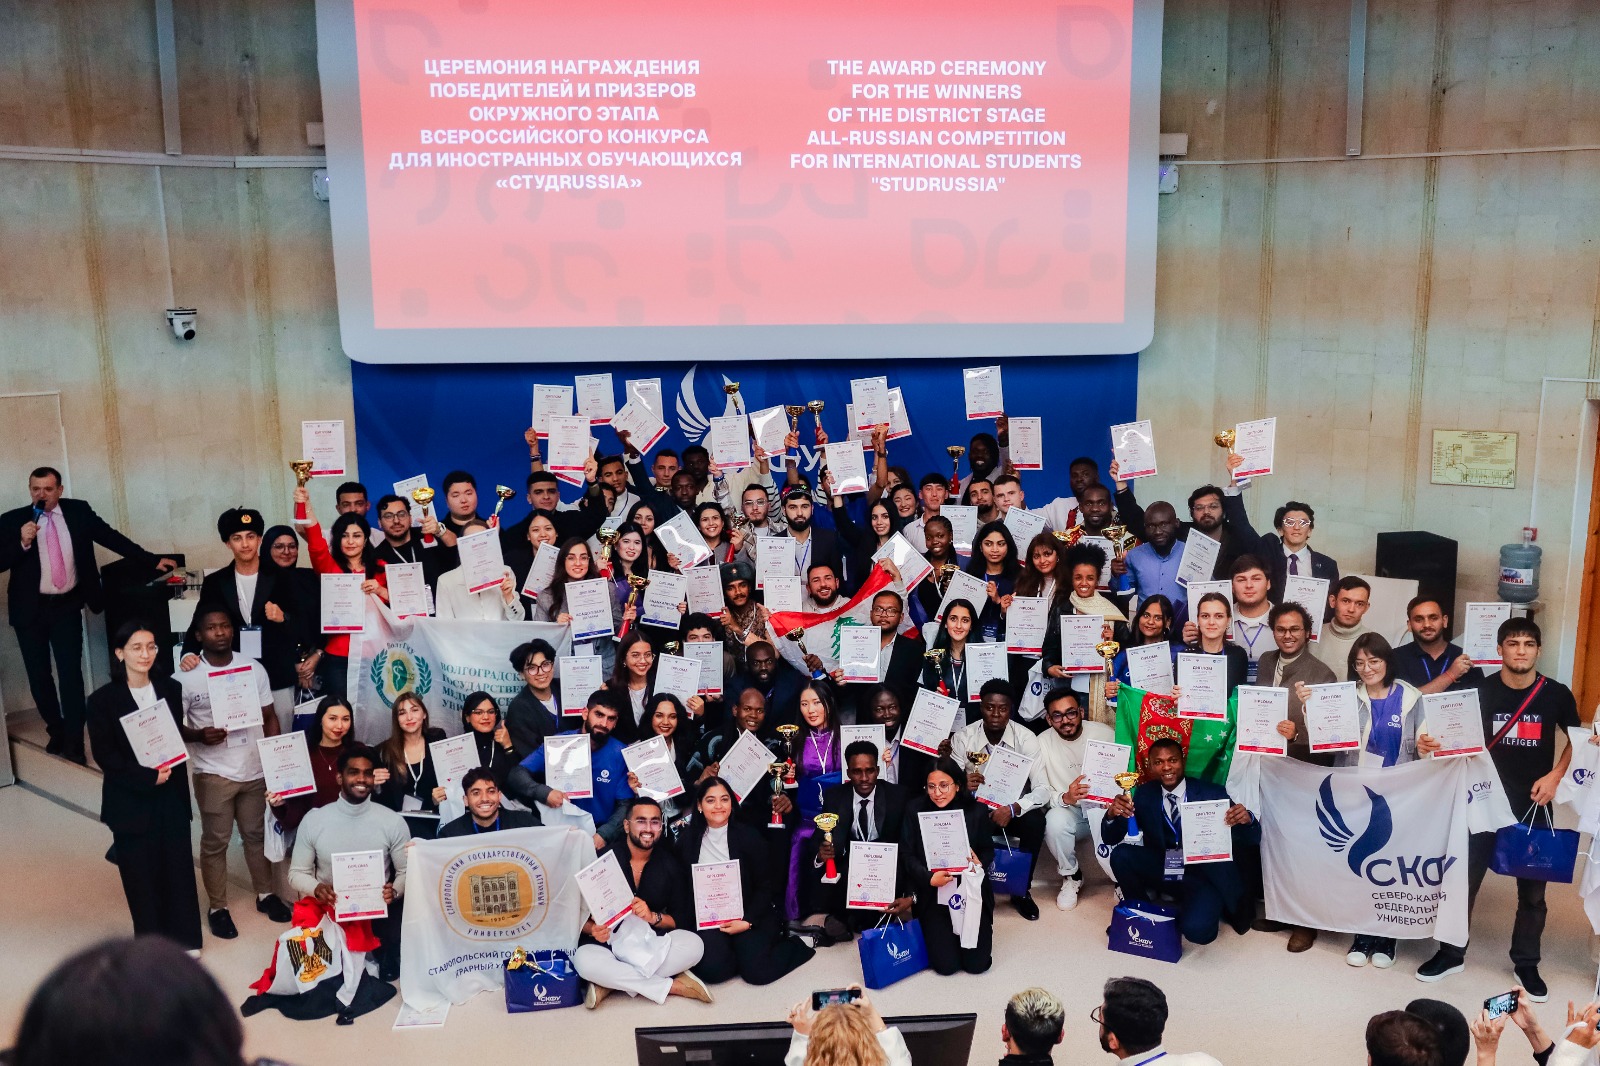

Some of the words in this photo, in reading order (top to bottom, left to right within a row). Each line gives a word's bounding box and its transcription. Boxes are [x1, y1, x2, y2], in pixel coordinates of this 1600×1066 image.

[424, 59, 547, 76] ЦЕРЕМОНИЯ
[551, 59, 700, 77] НАГРАЖДЕНИЯ
[827, 60, 863, 76] THE
[867, 60, 936, 76] AWARD
[940, 60, 1047, 76] CEREMONY
[430, 79, 573, 100] ПОБЕДИТЕЛЕЙ
[577, 82, 591, 98] И
[595, 82, 696, 98] ПРИЗЕРОВ
[852, 83, 889, 99] FOR
[894, 83, 930, 99] THE
[934, 83, 1022, 99] WINNERS
[469, 106, 592, 122] ОКРУЖНОГО
[596, 106, 660, 122] ЭТАПА
[827, 107, 852, 123] OF
[857, 107, 893, 123] THE
[897, 107, 982, 123] DISTRICT
[986, 107, 1045, 123] STAGE
[420, 125, 603, 145] ВСЕРОССИЙСКОГО
[608, 129, 710, 144] КОНКУРСА
[807, 130, 933, 146] ALL-RUSSIAN
[937, 130, 1066, 146] COMPETITION
[388, 152, 432, 170] ДЛЯ
[436, 152, 582, 168] ИНОСТРАННЫХ
[587, 151, 742, 169] ОБУЧАЮЩИХСЯ
[790, 153, 828, 169] FOR
[832, 153, 980, 169] INTERNATIONAL
[985, 153, 1082, 169] STUDENTS
[495, 174, 643, 192] «СТУДRUSSIA»
[871, 176, 1006, 192] "STUDRUSSIA"
[440, 661, 525, 682] ВОЛГОГРАДСК
[442, 673, 524, 694] ГОСУДАРСТВЕ
[1496, 713, 1540, 723] TOMY
[1499, 737, 1538, 747] ILFIGER
[467, 850, 540, 872] ГОСУДАРСТВЕННЫЙ
[1374, 902, 1439, 915] ФЕДЕРАЛЬН
[467, 921, 533, 937] УНИВЕРСИТЕТ
